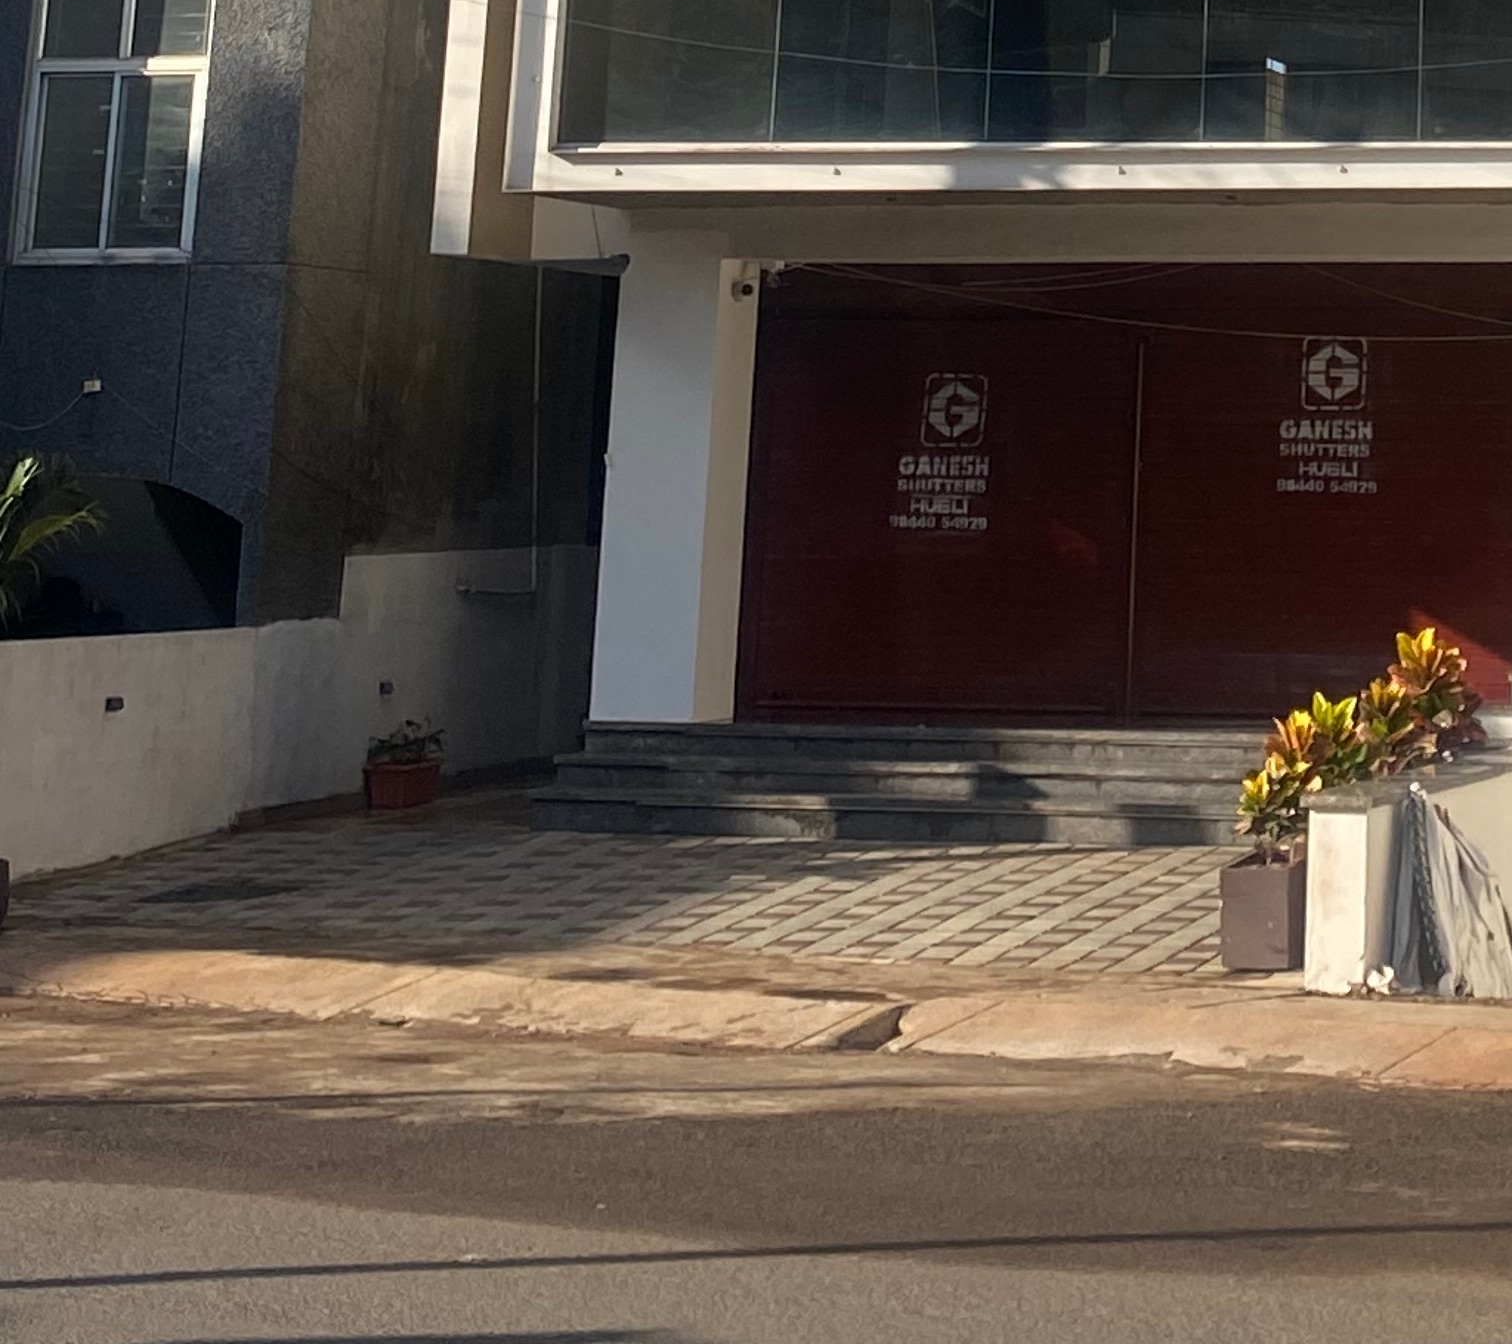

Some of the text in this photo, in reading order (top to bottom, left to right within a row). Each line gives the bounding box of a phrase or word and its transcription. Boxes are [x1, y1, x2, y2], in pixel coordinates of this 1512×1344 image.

[1279, 419, 1374, 440] GANESH
[1279, 442, 1371, 458] SHUTTERS
[898, 454, 990, 476] GANESH
